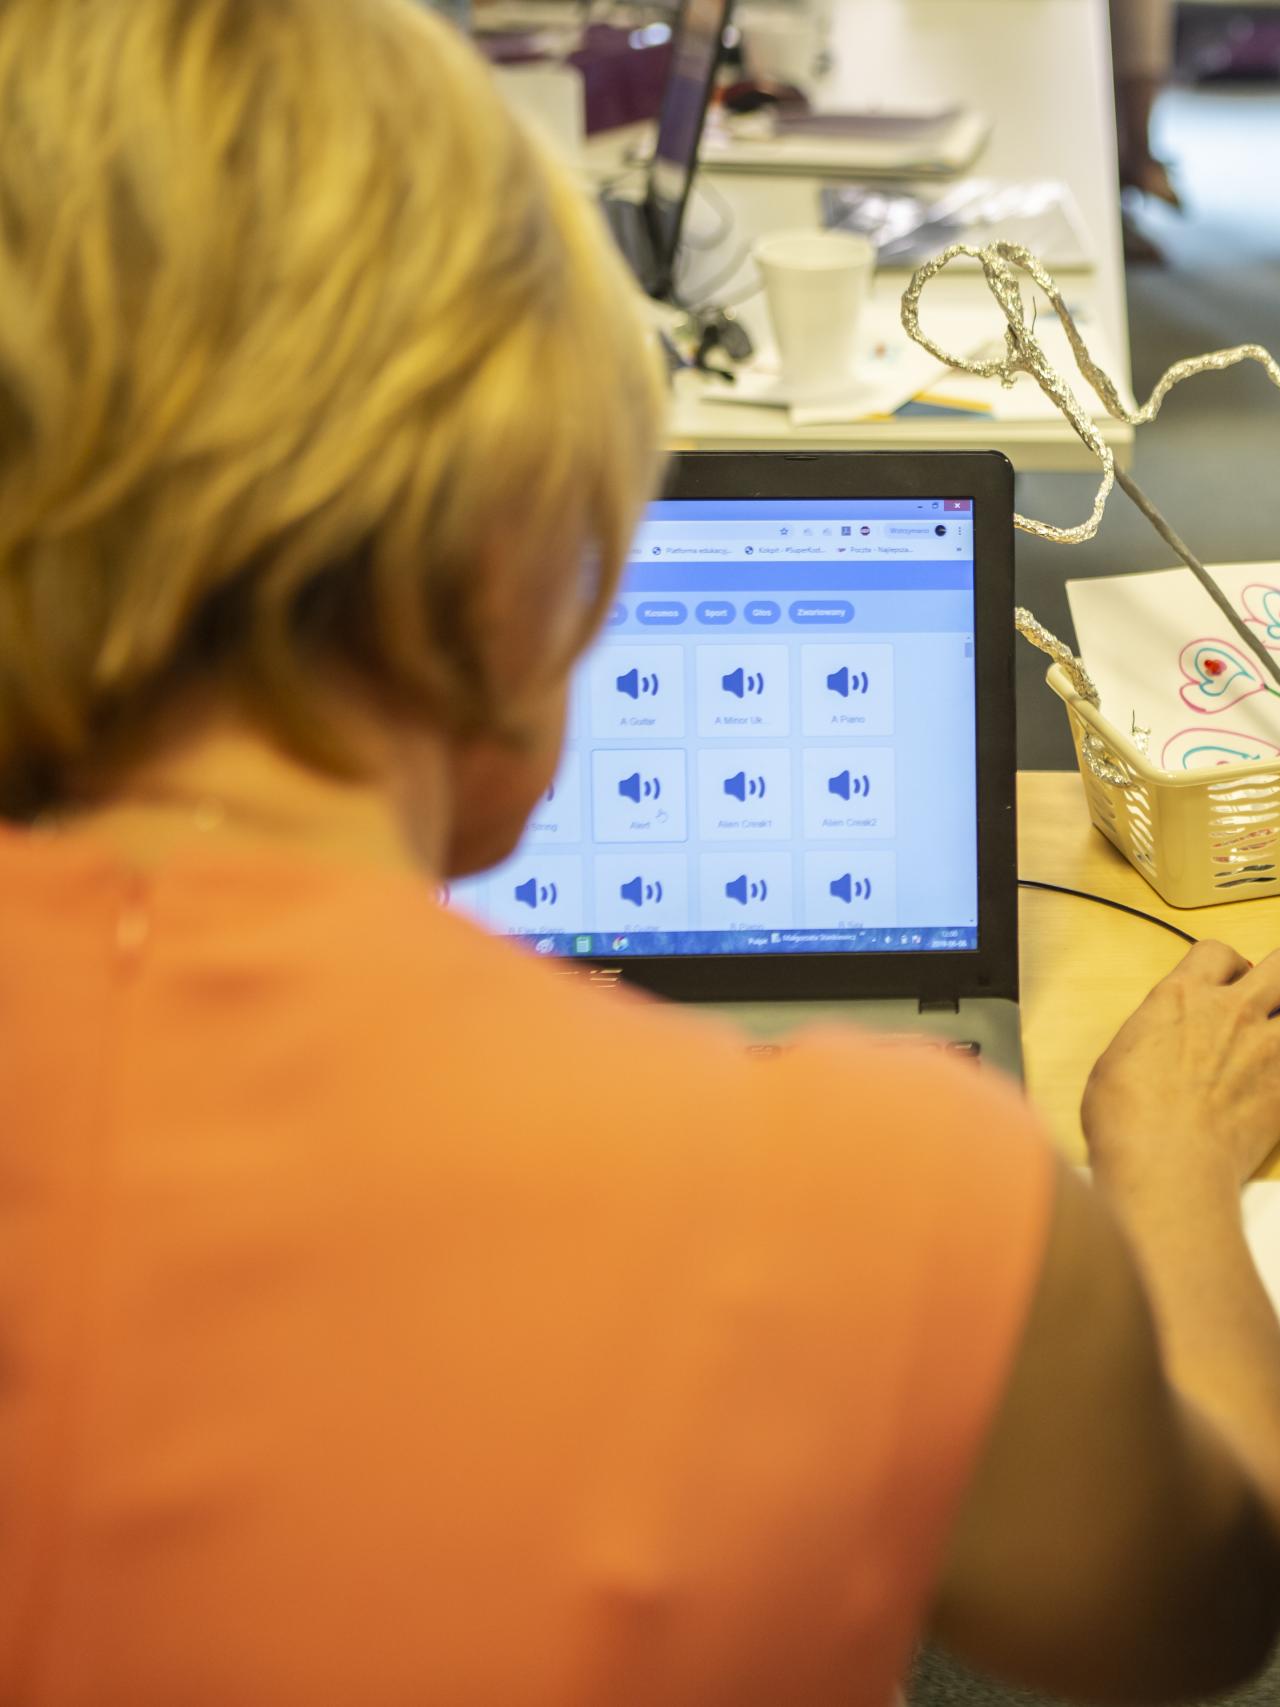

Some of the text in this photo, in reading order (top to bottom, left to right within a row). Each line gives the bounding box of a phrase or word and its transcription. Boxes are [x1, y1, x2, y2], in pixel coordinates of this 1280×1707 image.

[644, 607, 680, 618] Kosmos
[704, 607, 728, 619] Sport
[797, 607, 847, 618] Zwariowany
[629, 716, 657, 726] Guitar
[724, 715, 749, 725] Minor
[840, 714, 866, 724] Piano
[630, 820, 651, 830] Alert
[717, 819, 739, 828] Alien
[821, 817, 843, 827] Alien
